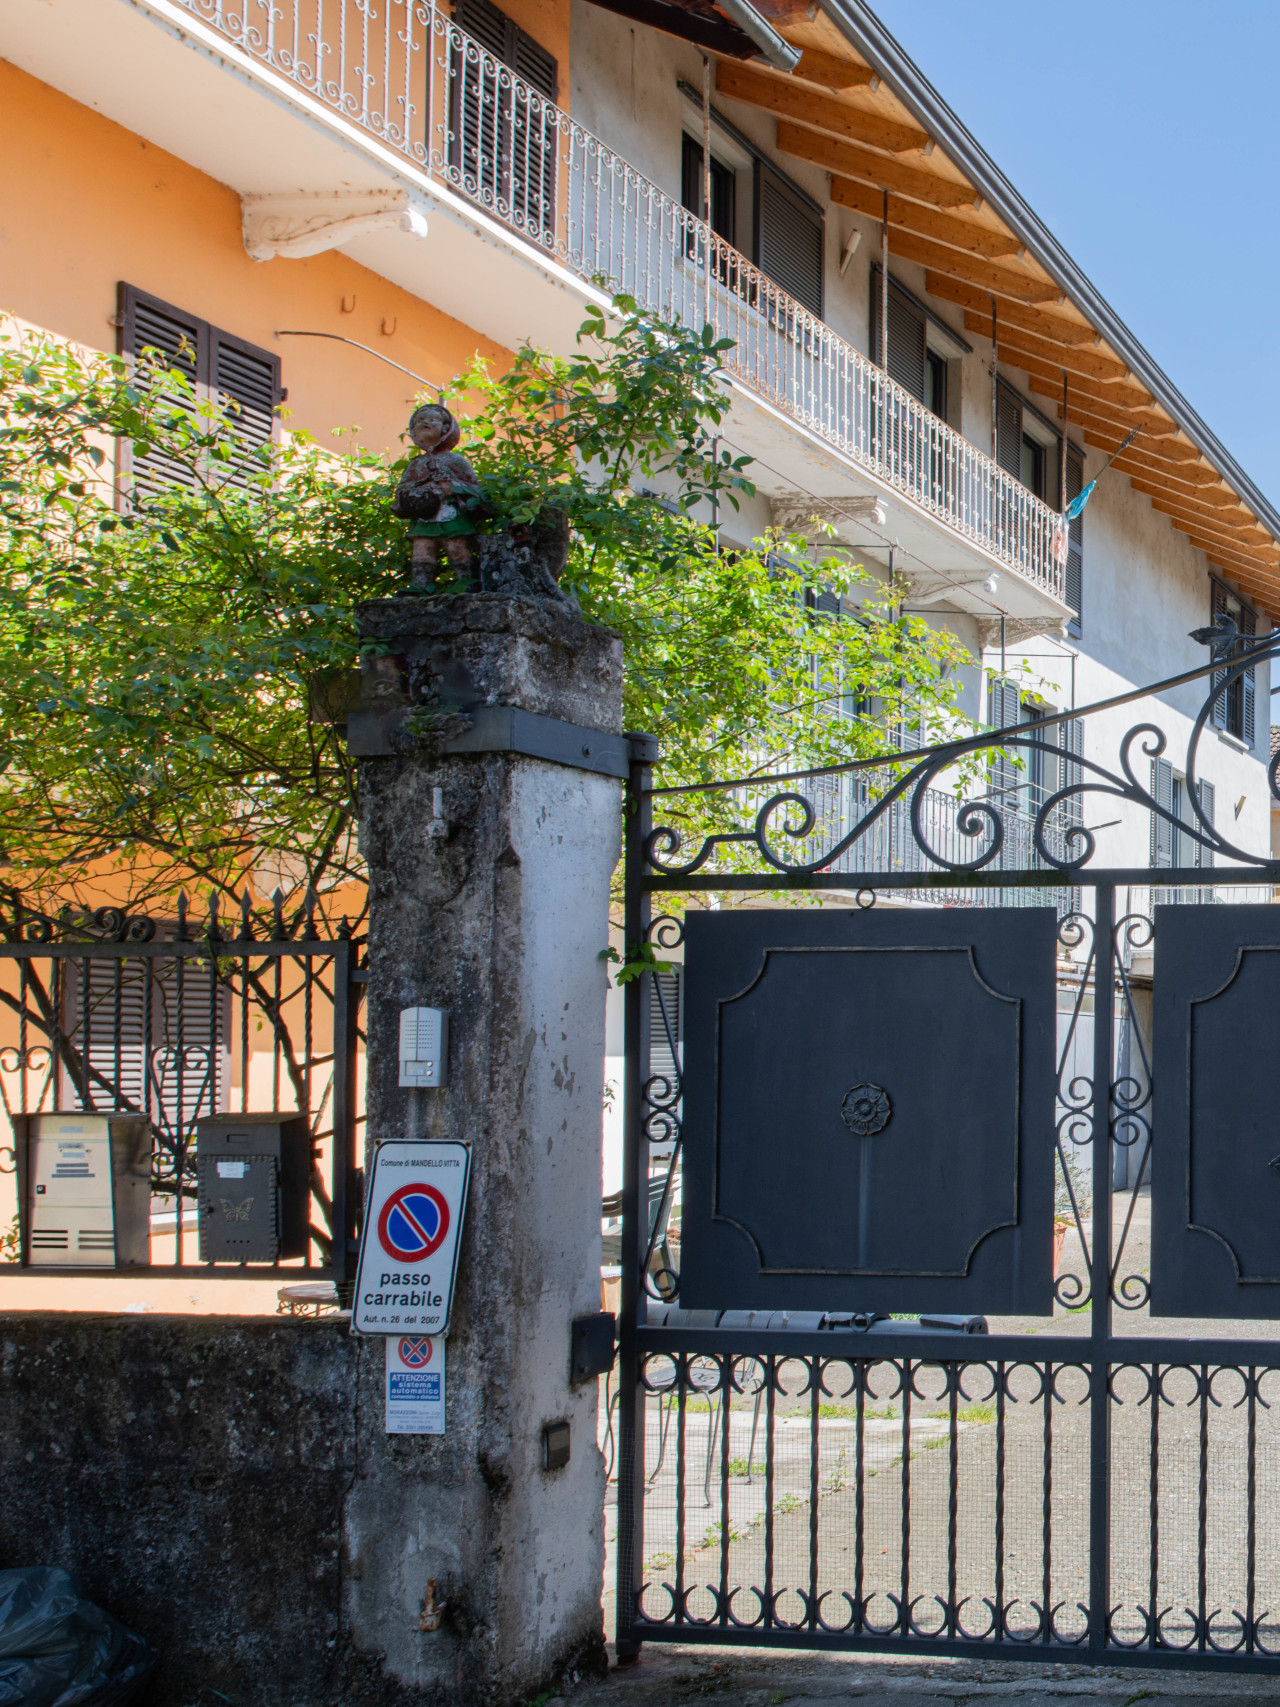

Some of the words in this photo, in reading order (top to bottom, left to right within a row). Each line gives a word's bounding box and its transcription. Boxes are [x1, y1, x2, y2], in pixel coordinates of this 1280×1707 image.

[380, 1159, 404, 1167] Comune
[404, 1159, 410, 1167] di
[411, 1159, 443, 1168] MANDELLO
[380, 1272, 431, 1287] passo
[364, 1291, 443, 1307] carrabile
[363, 1314, 380, 1323] Aut.
[390, 1315, 400, 1323] 26
[404, 1315, 417, 1323] del
[421, 1316, 441, 1324] 2007
